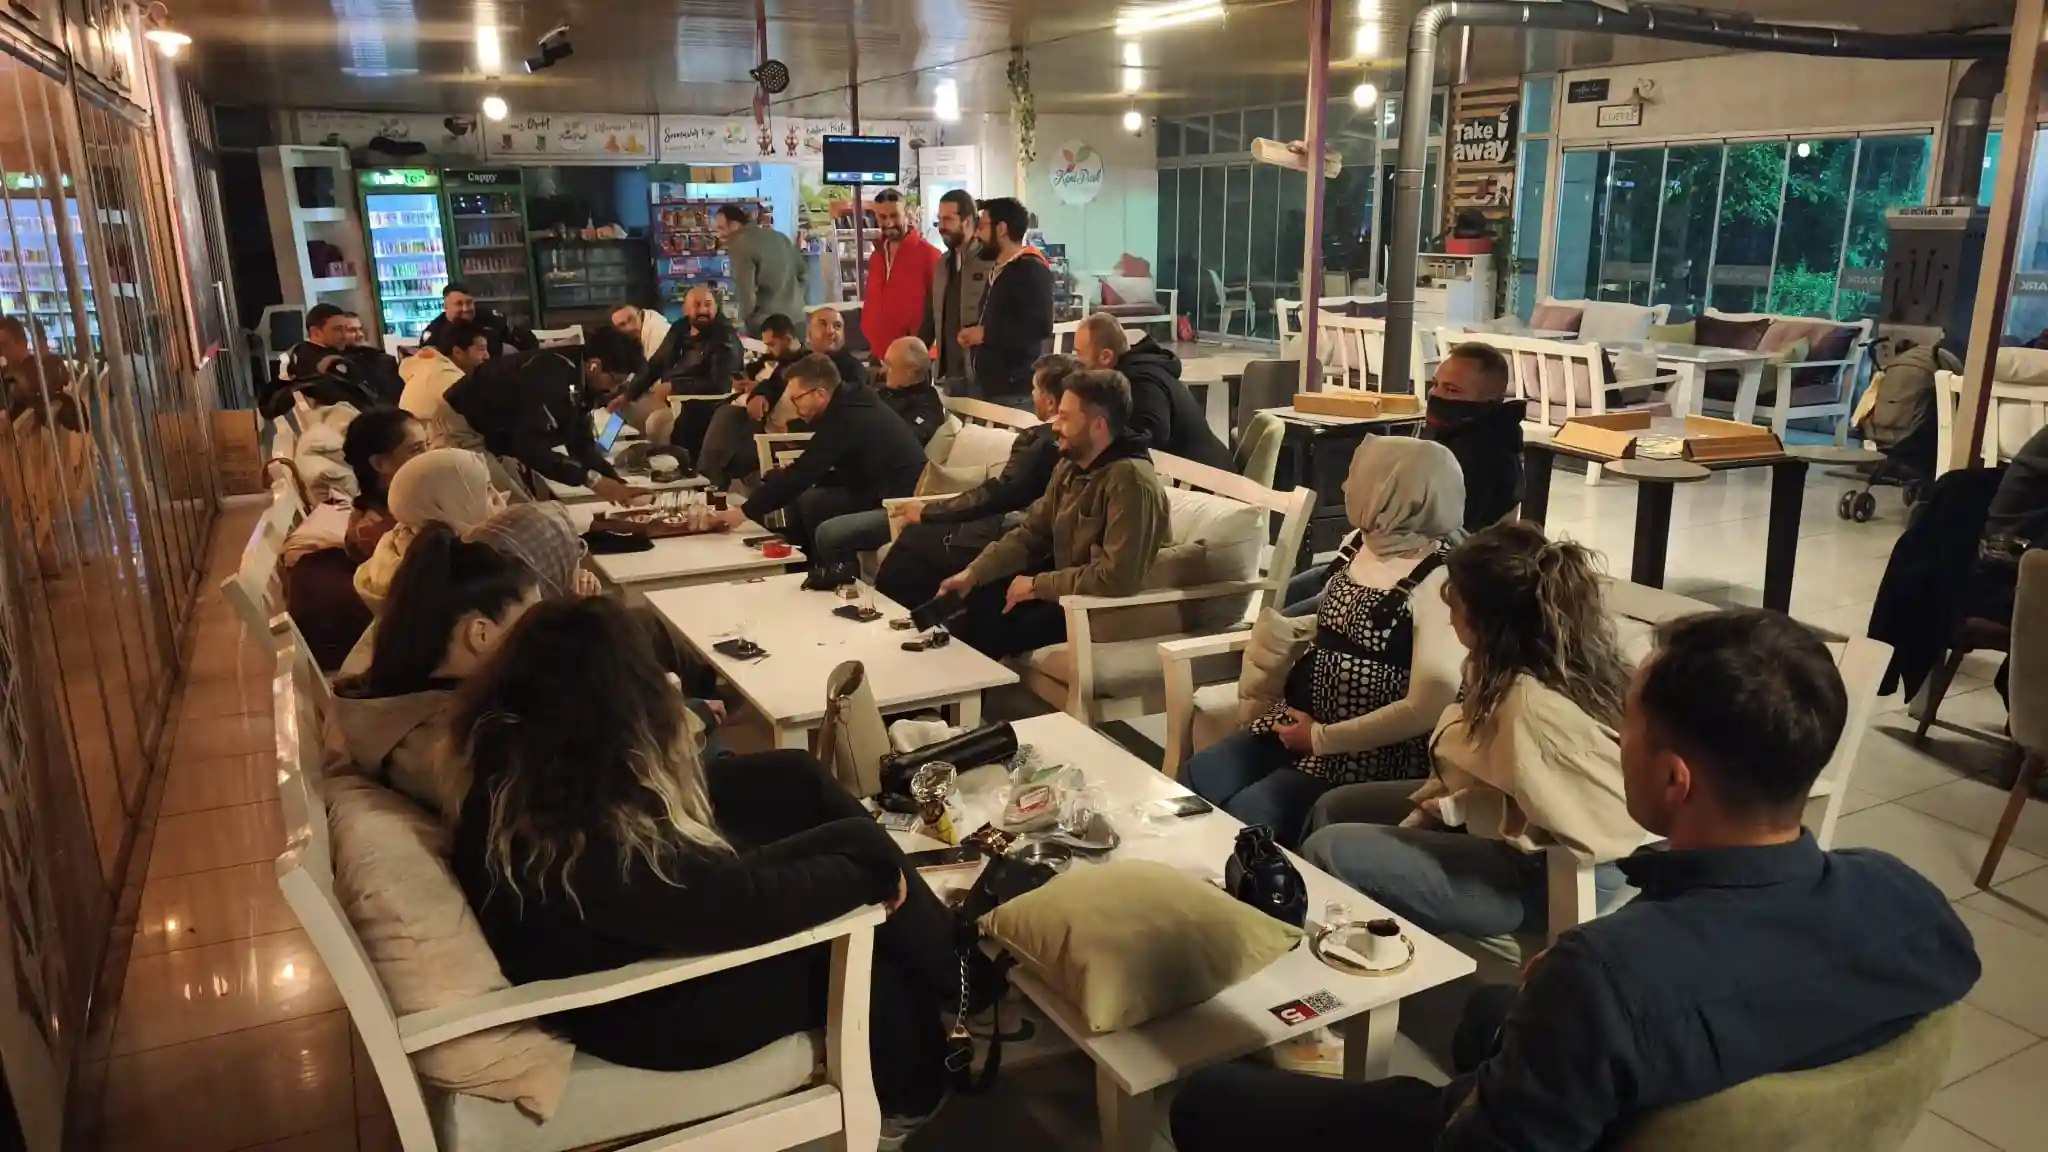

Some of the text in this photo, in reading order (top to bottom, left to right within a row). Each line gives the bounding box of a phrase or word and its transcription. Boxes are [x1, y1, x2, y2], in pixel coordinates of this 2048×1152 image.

[1453, 120, 1494, 141] Take
[1453, 139, 1509, 161] away
[467, 172, 498, 184] Cappy
